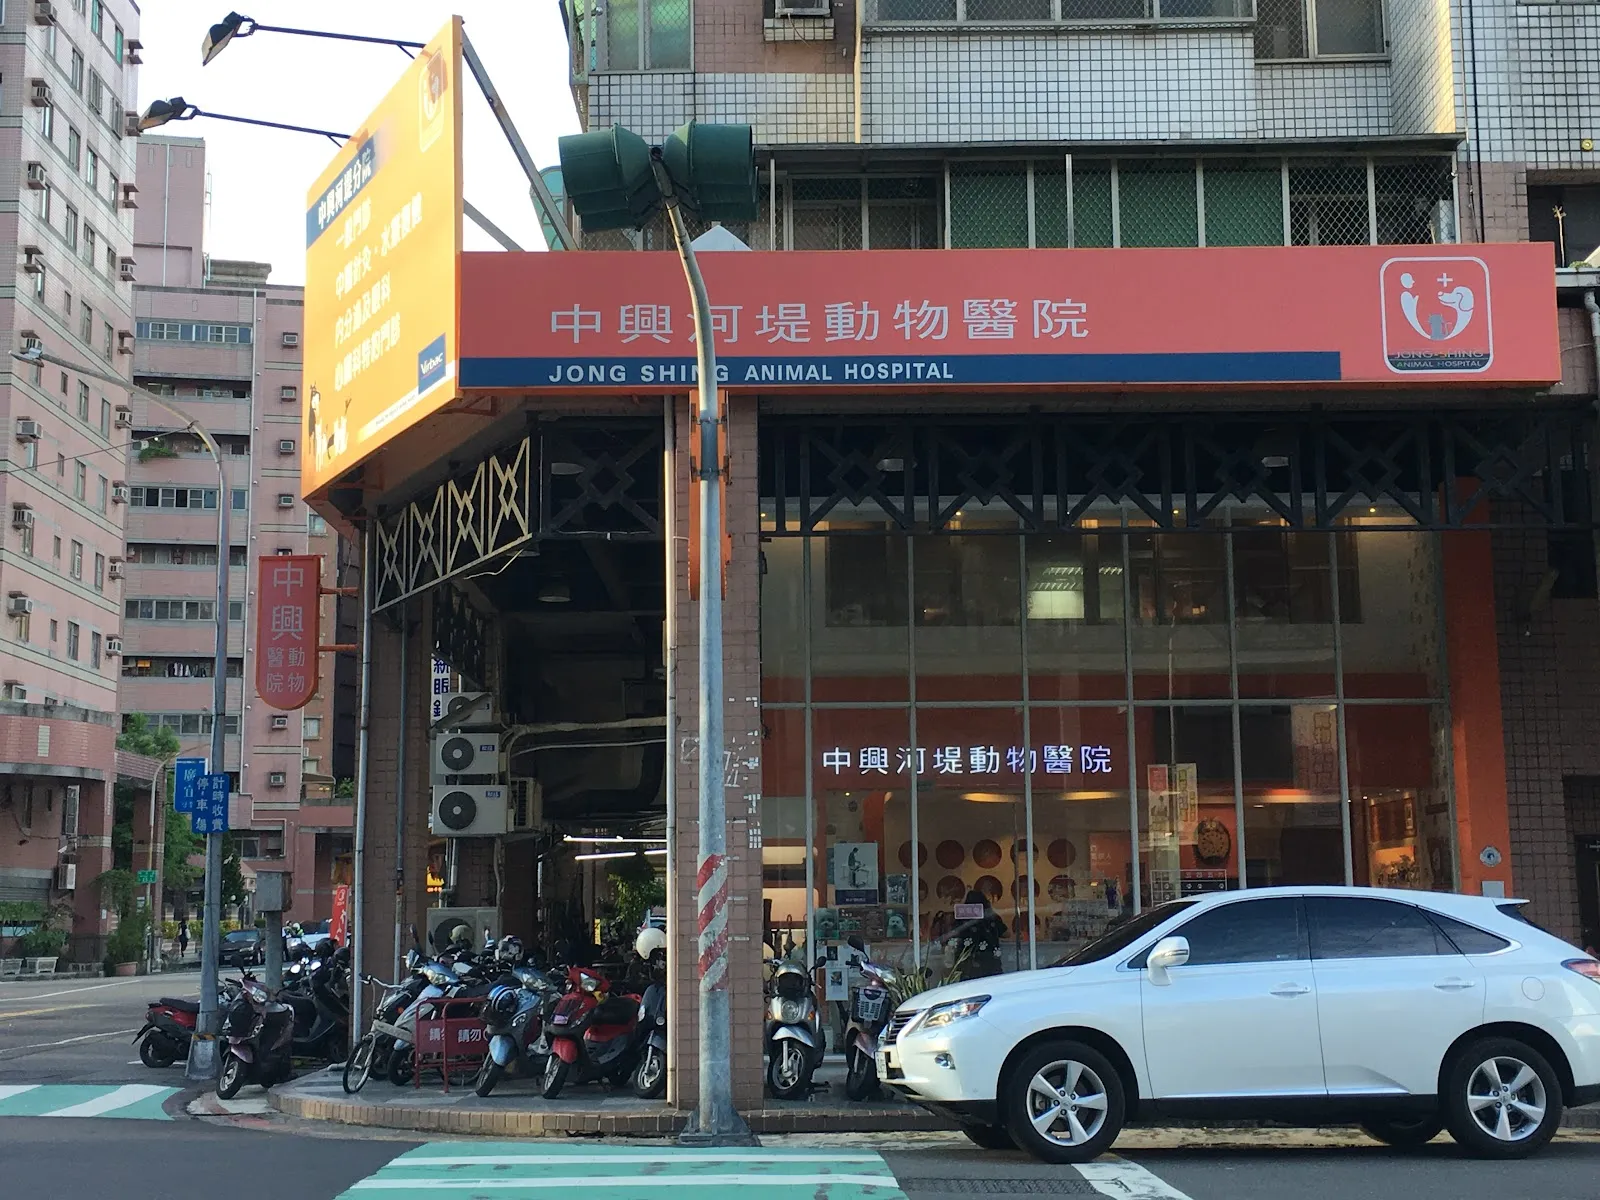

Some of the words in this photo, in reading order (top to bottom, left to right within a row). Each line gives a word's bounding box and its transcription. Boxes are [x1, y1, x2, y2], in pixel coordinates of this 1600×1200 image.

[551, 298, 1089, 344] 中興河堤動物醫院
[420, 352, 444, 375] Virbac
[548, 365, 626, 382] JONG
[744, 364, 833, 381] ANIMAL
[844, 362, 954, 380] HOSPITAL
[1396, 360, 1434, 368] ANIMAL
[1437, 359, 1482, 368] HOSPITAL
[271, 560, 304, 641] 中興
[822, 745, 1112, 775] 中興河堤動物醫院
[457, 1028, 489, 1043] 請勿
